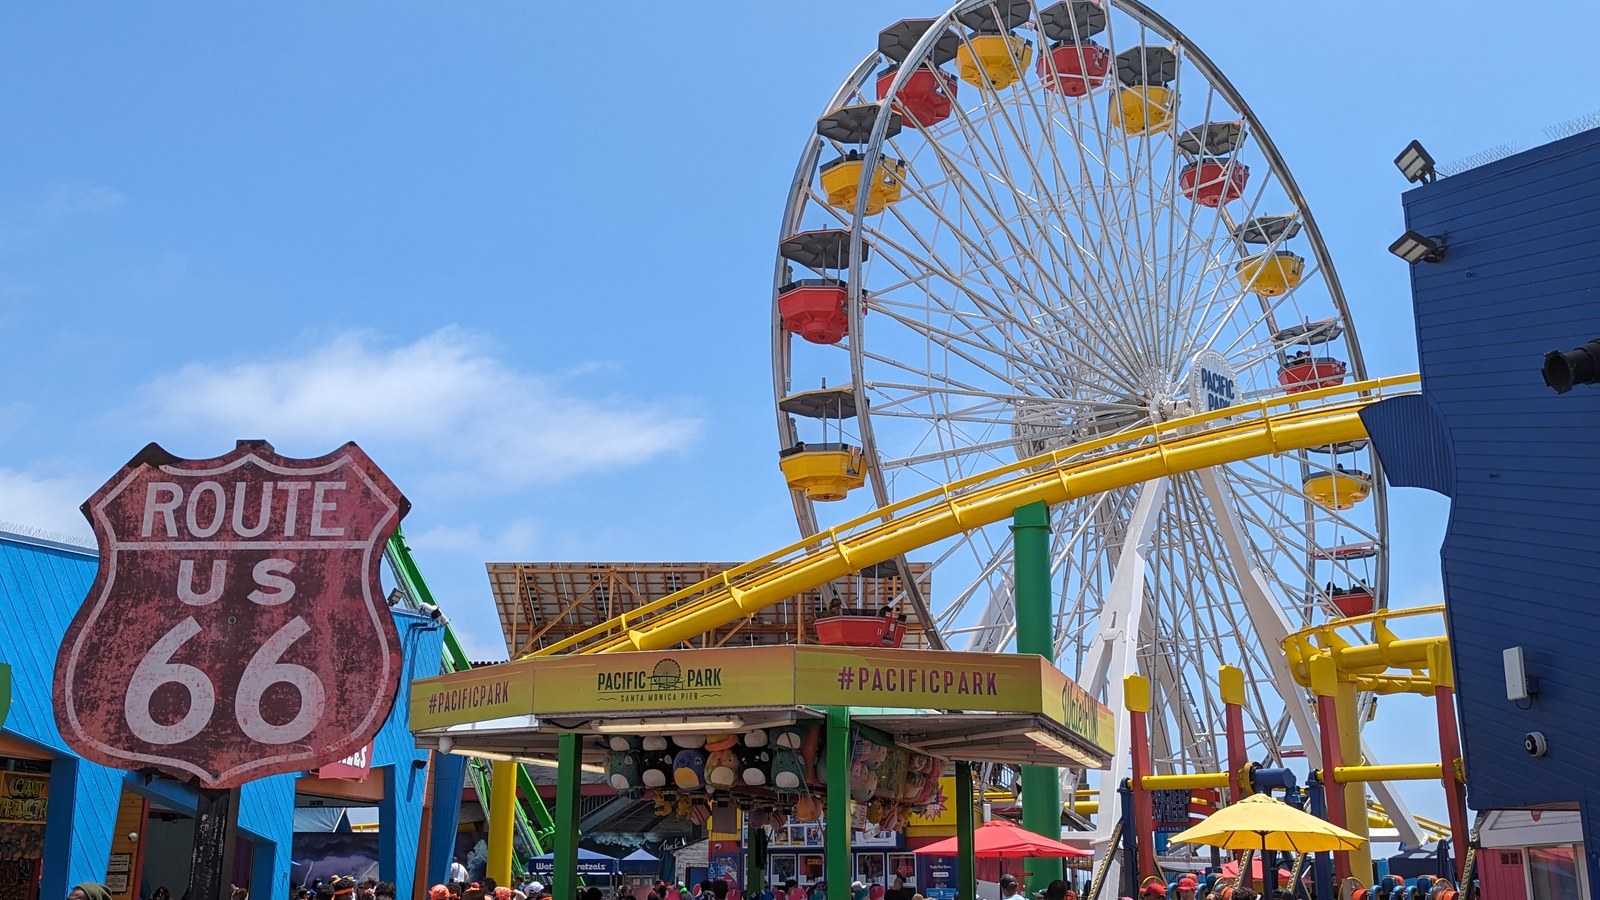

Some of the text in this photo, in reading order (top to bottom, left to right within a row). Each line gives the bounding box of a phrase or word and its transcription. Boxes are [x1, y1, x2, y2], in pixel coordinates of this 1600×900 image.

[1201, 367, 1234, 400] PACIFIC
[141, 480, 347, 538] ROUTE
[124, 615, 326, 745] 66
[597, 668, 722, 691] PACIFIC PARK
[837, 666, 998, 696] #PACIFICPARK
[428, 681, 509, 715] #PACIFICPARK
[620, 692, 698, 703] SANTA MONICA PIER
[9, 778, 46, 797] CAT
[577, 862, 607, 871] retzels
